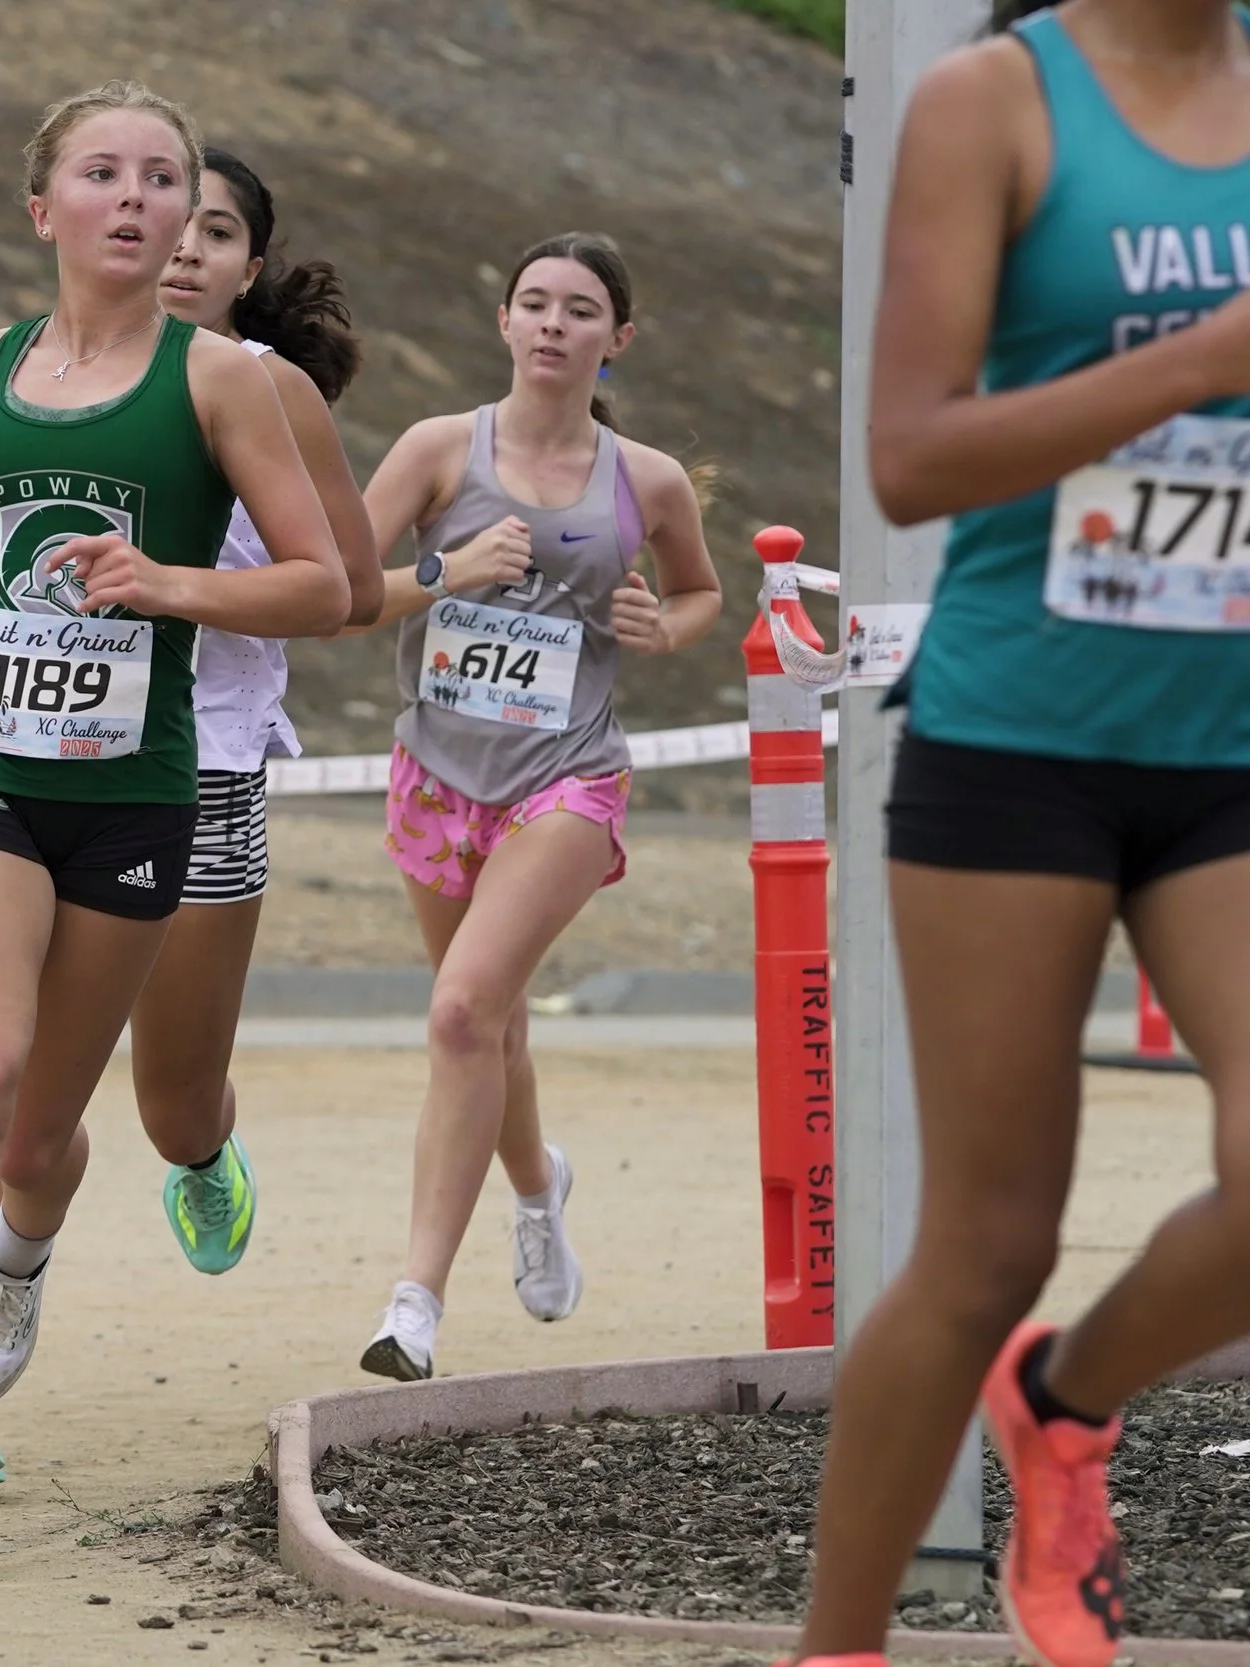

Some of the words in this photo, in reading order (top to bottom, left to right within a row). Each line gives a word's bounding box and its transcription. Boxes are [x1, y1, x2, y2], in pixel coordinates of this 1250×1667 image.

[1131, 478, 1250, 560] 171
[26, 628, 52, 648] n'
[57, 621, 139, 657] Grind
[439, 603, 479, 630] Grit
[507, 616, 569, 646] Grind
[458, 642, 540, 690] 614
[484, 687, 503, 704] XC
[503, 690, 557, 717] Challenge
[35, 717, 58, 736] XC
[60, 718, 128, 744] Challenge
[59, 738, 102, 757] 2025
[118, 873, 156, 889] adidas
[802, 962, 831, 1134] TRAFFIC
[808, 1164, 835, 1319] SAFETY
